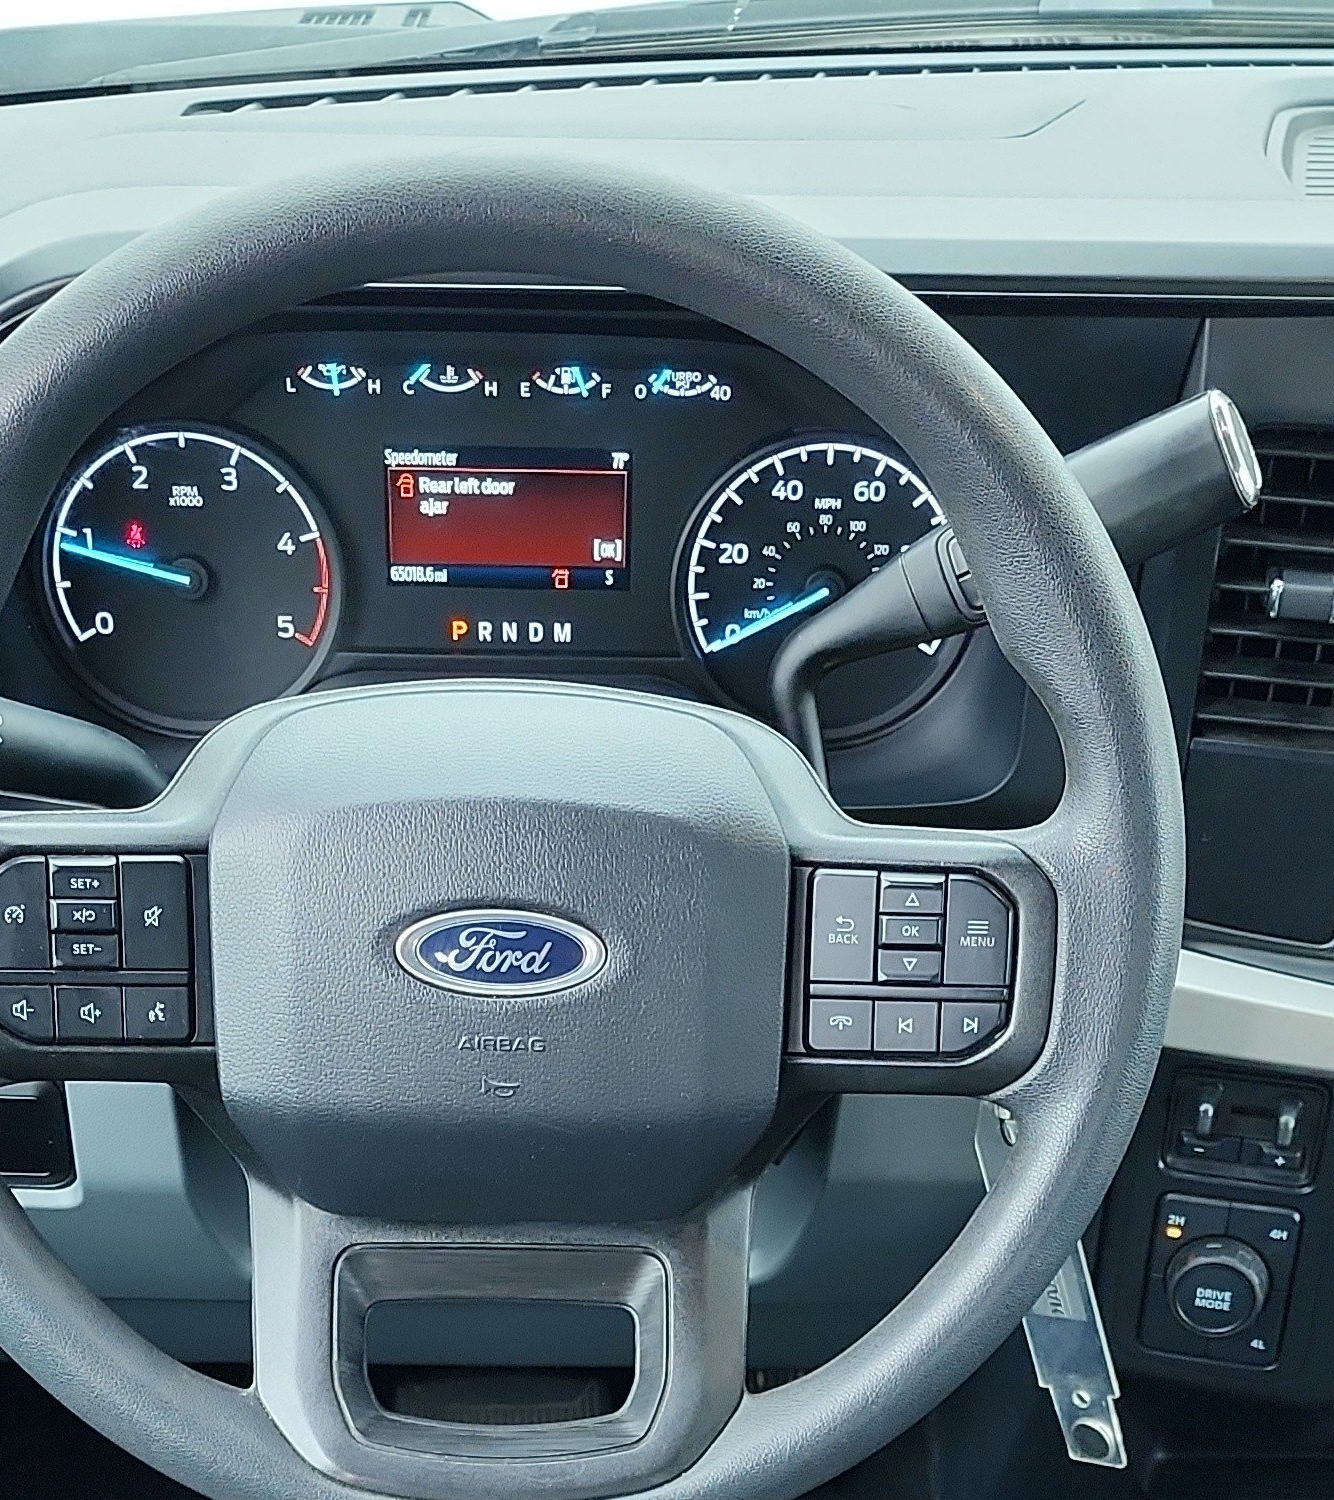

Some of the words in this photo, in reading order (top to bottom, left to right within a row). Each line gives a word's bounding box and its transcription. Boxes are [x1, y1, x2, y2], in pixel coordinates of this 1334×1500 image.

[285, 377, 297, 393] L
[367, 378, 381, 395] H
[484, 380, 498, 397] H
[519, 381, 531, 398] E
[601, 383, 612, 399] F
[709, 385, 732, 401] 40
[384, 448, 458, 467] Speedometer
[132, 465, 149, 490] 2
[220, 467, 238, 491] 3
[418, 476, 453, 494] Rear
[454, 477, 480, 495] left
[481, 477, 516, 496] door
[171, 485, 199, 497] RPM
[771, 479, 804, 501] 40
[853, 480, 886, 502] 60
[419, 498, 450, 517] ajar
[814, 499, 842, 510] MPH
[849, 521, 866, 532] 100
[276, 532, 296, 556] 4
[718, 543, 749, 565] 20
[94, 611, 114, 635] 0
[277, 615, 295, 639] 5
[452, 620, 468, 641] P
[477, 621, 493, 642] R
[502, 621, 518, 643] N
[528, 622, 544, 643] D
[553, 622, 572, 643] M
[828, 933, 859, 945] BACK
[901, 925, 920, 937] OK
[959, 936, 996, 947] MENU
[434, 927, 553, 974] Ford
[457, 1035, 547, 1052] AIRBAG
[1167, 1214, 1186, 1227] 2H
[1268, 1228, 1288, 1241] 4H
[1196, 1287, 1233, 1302] DRIVE
[1194, 1298, 1231, 1311] MODE
[1249, 1338, 1266, 1350] 4L
